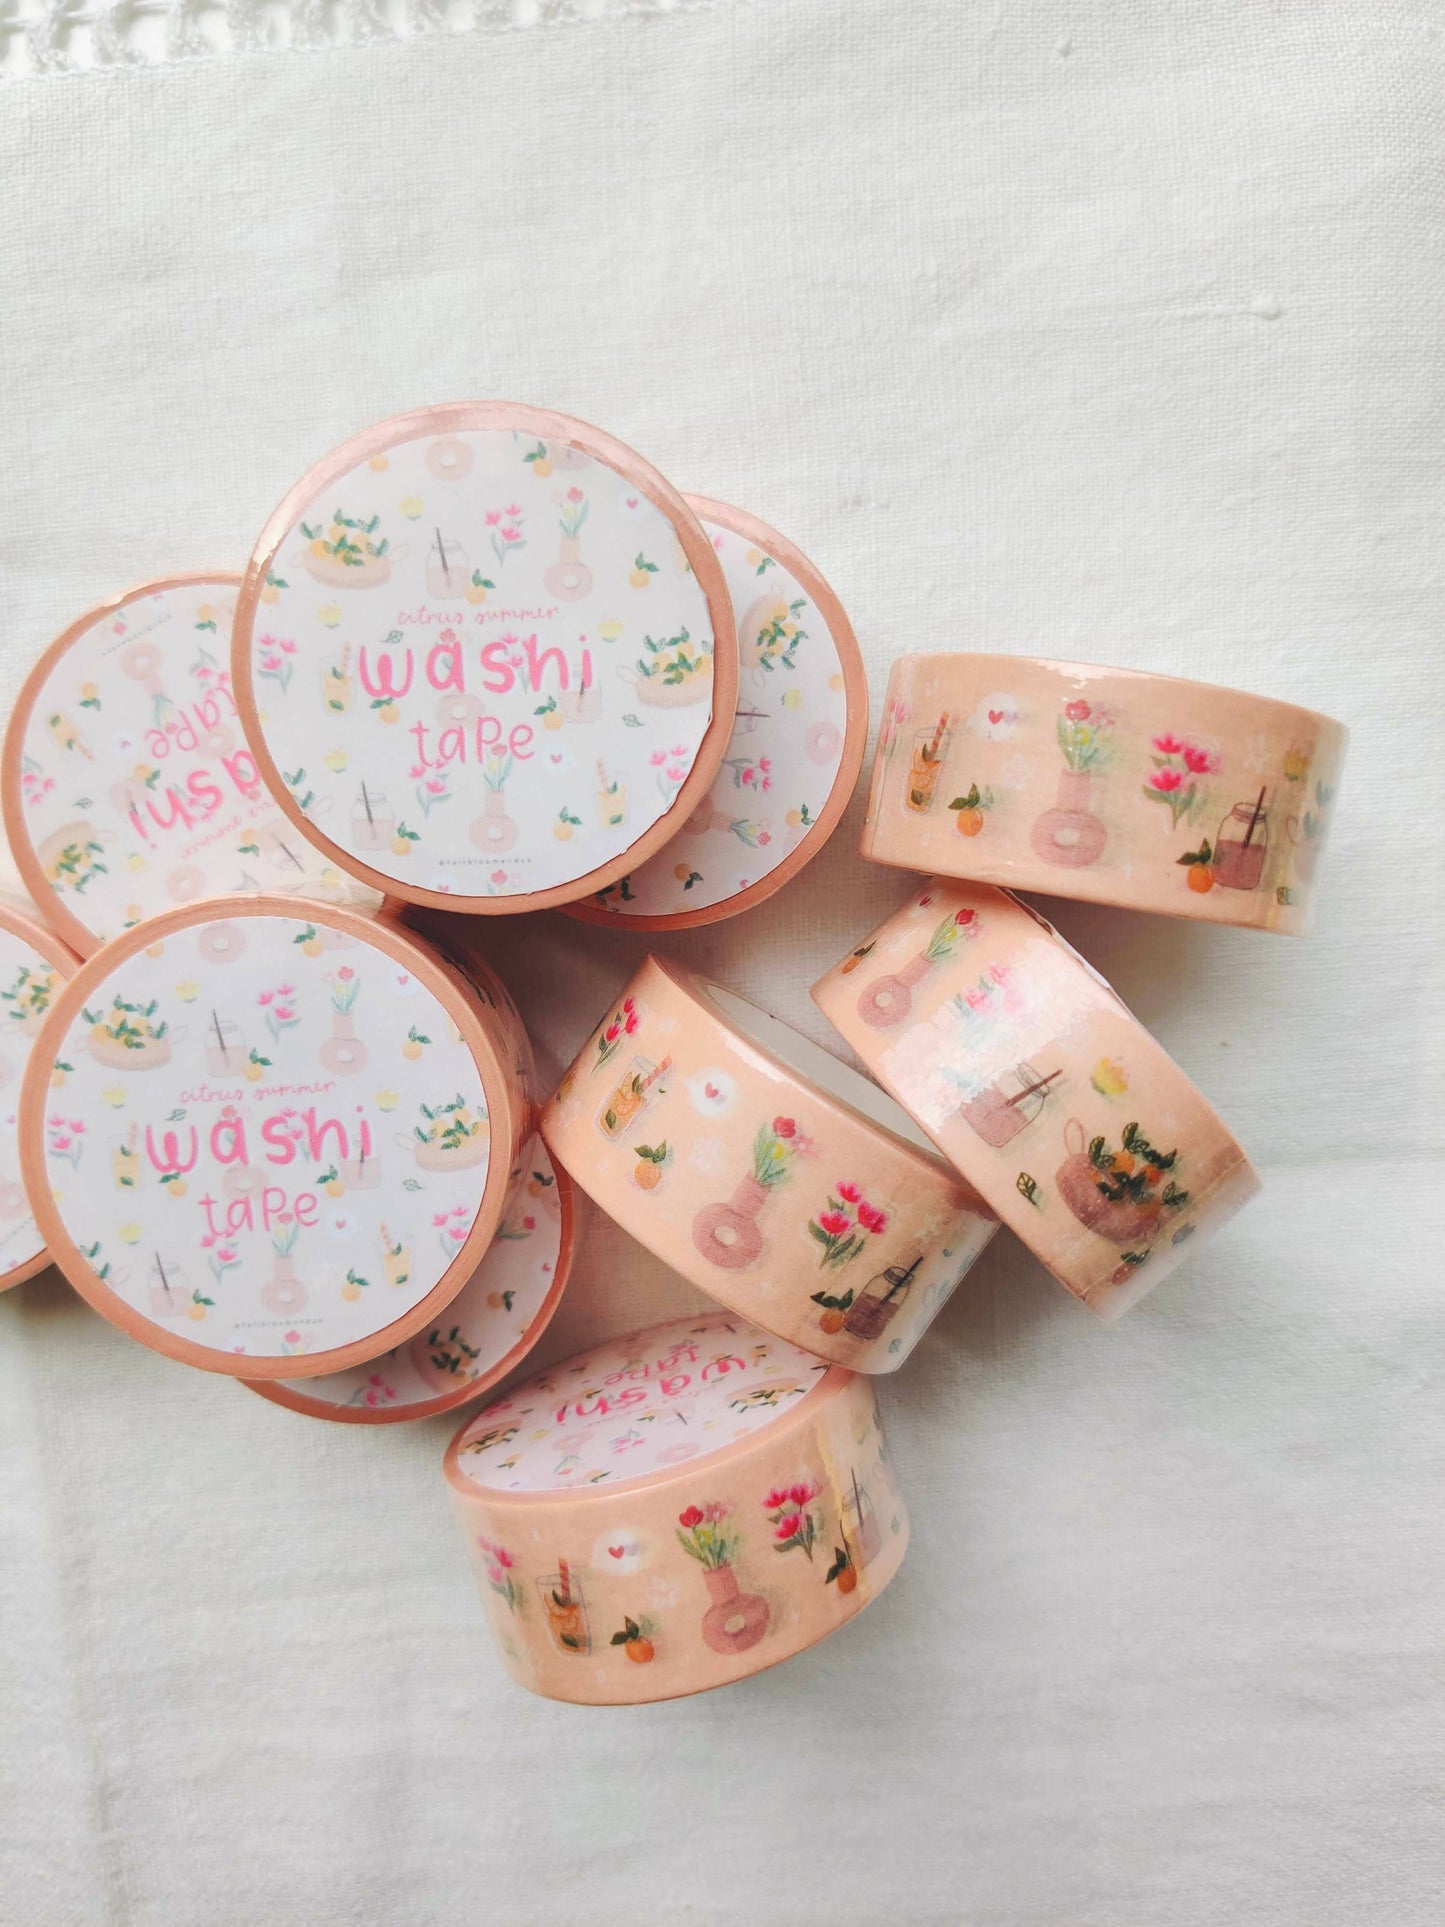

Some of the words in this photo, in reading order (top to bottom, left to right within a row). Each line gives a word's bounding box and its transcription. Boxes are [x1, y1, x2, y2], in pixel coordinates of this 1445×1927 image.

[398, 605, 464, 625] citrus
[474, 605, 559, 625] summer
[359, 633, 593, 699] washi
[129, 750, 262, 849] ashi
[180, 1083, 243, 1104] citrus
[254, 1081, 336, 1101] summer
[145, 1105, 372, 1173] washi
[556, 1356, 746, 1426] washi
